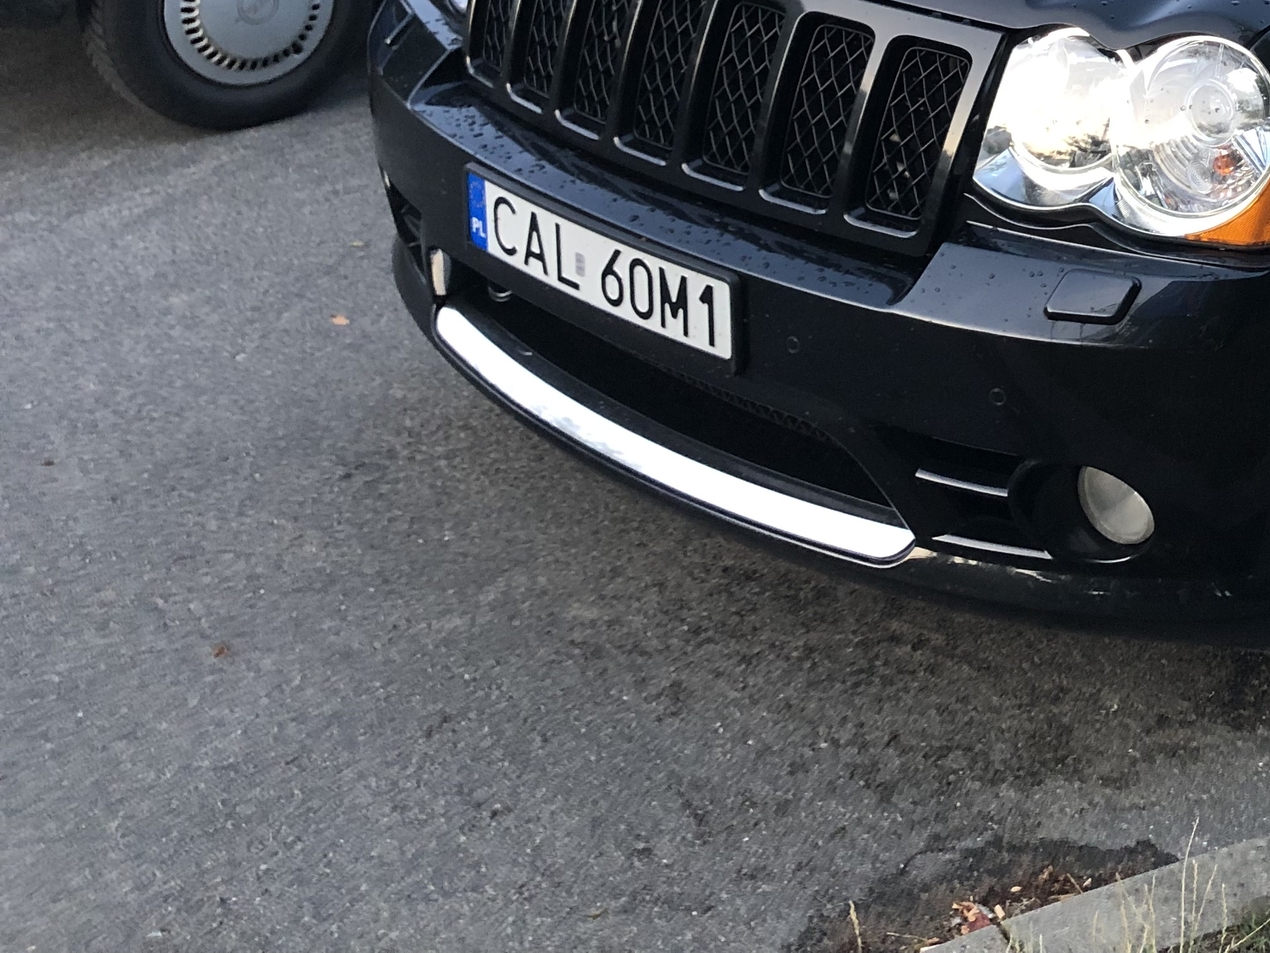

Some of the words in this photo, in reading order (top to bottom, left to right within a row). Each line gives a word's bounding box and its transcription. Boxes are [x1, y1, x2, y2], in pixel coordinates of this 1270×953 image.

[472, 216, 487, 238] PL
[493, 196, 581, 291] CAL
[601, 248, 716, 348] 60M1
